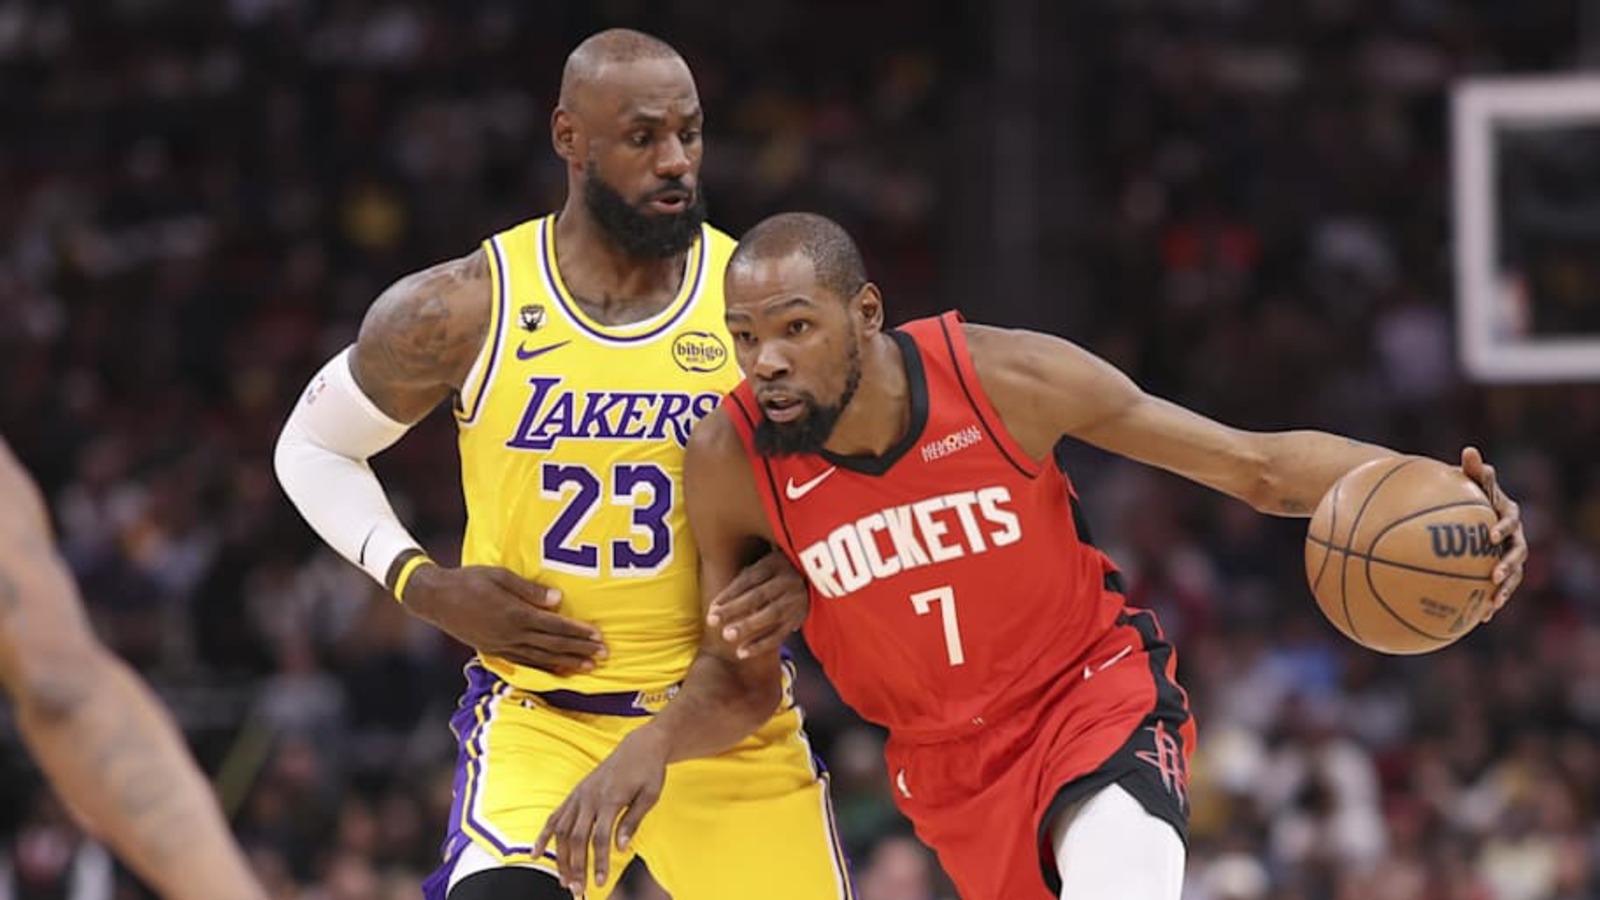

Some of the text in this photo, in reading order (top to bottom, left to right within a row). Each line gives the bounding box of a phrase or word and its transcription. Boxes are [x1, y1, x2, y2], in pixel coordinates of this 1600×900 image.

[676, 342, 724, 362] bibigo
[541, 463, 674, 576] 23
[798, 486, 1022, 598] ROCKETS
[1427, 522, 1503, 559] Wil
[910, 585, 965, 666] 7
